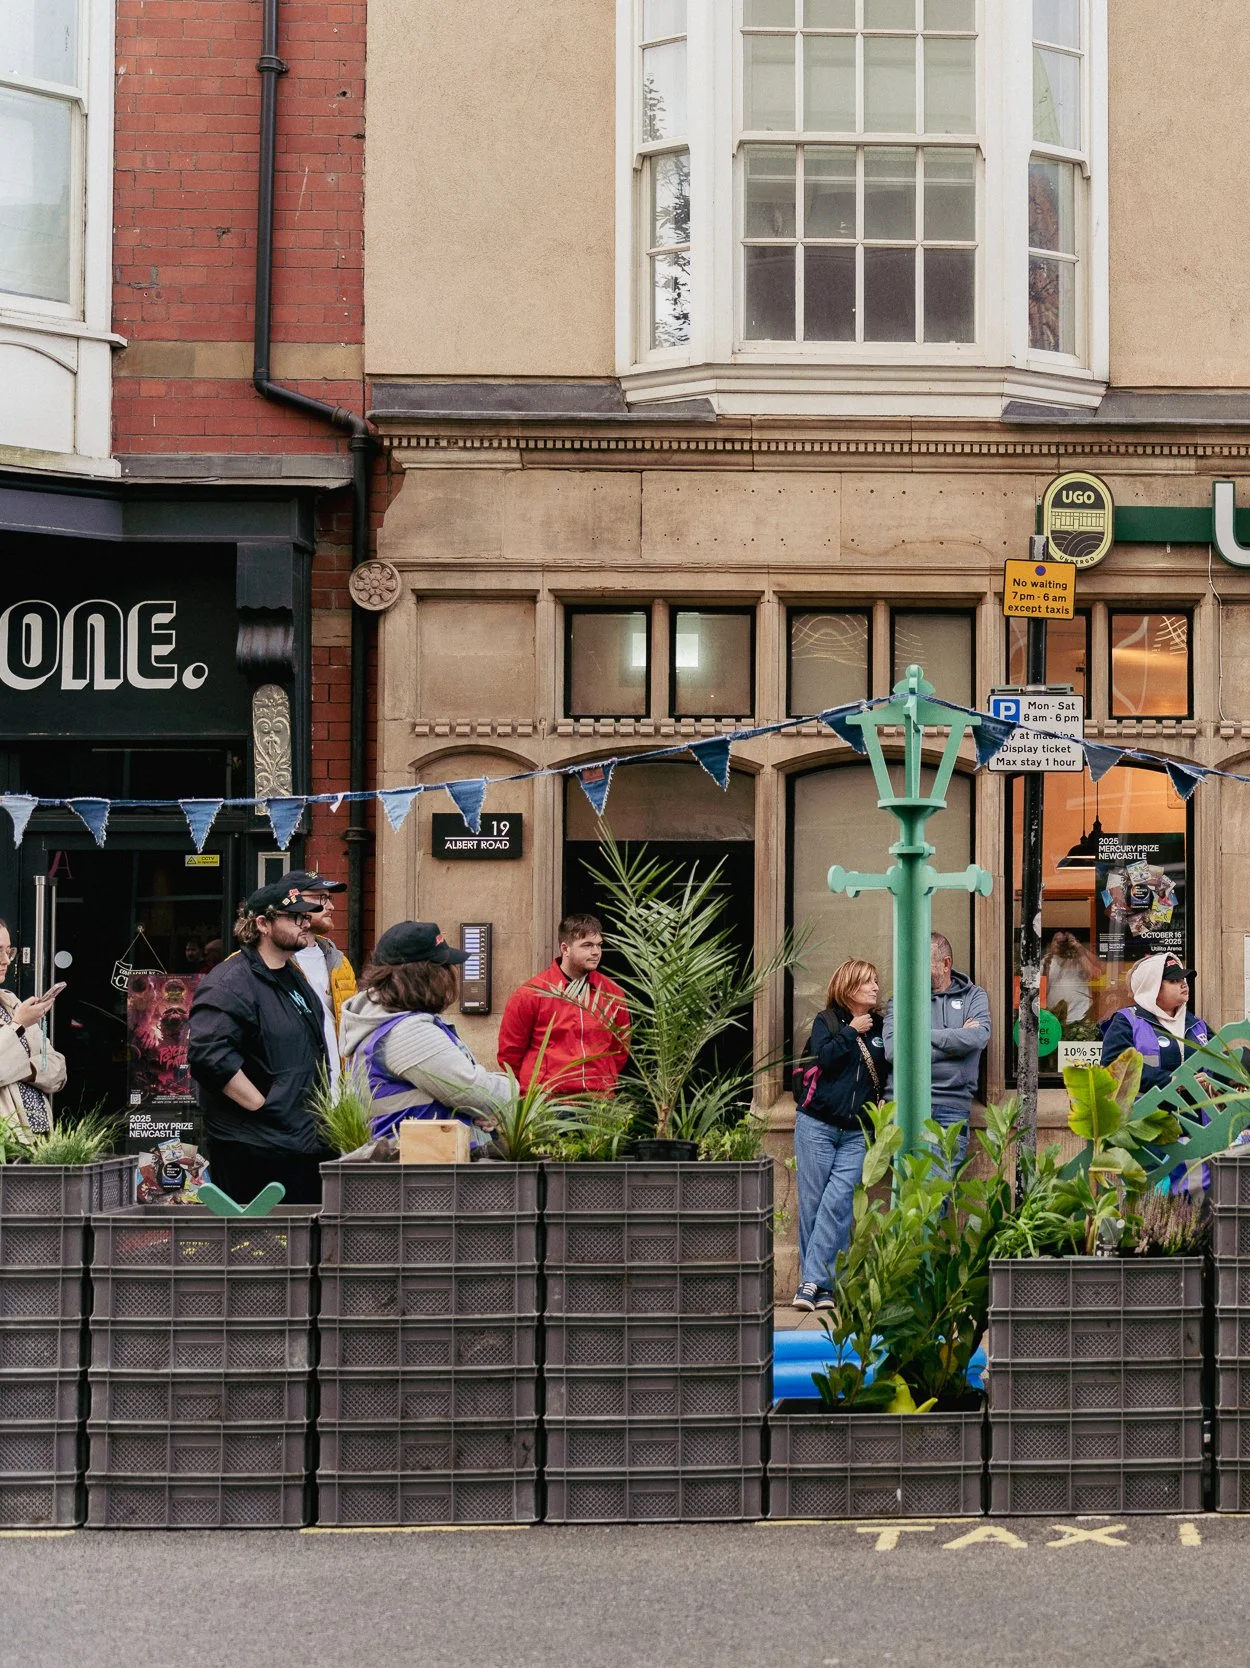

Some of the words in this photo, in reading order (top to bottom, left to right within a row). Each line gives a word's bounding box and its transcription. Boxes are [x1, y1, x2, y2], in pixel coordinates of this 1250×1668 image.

[1062, 490, 1095, 504] UGO
[1013, 578, 1027, 587] No
[1031, 580, 1068, 590] waiting
[1008, 604, 1042, 613] except
[1045, 605, 1070, 614] taxis
[0, 599, 209, 690] ONE.
[1028, 702, 1049, 710] Mon
[1057, 702, 1075, 710] Sat
[1020, 732, 1030, 740] at
[1002, 745, 1038, 754] Display
[1042, 745, 1071, 753] ticket
[997, 758, 1017, 766] Max
[1020, 759, 1041, 767] stay
[1045, 758, 1049, 766] 1
[1053, 758, 1076, 766] hour
[491, 821, 510, 836] 19
[444, 841, 478, 849] ALBERT
[481, 841, 510, 849] ROAD
[1064, 1047, 1087, 1056] 10%
